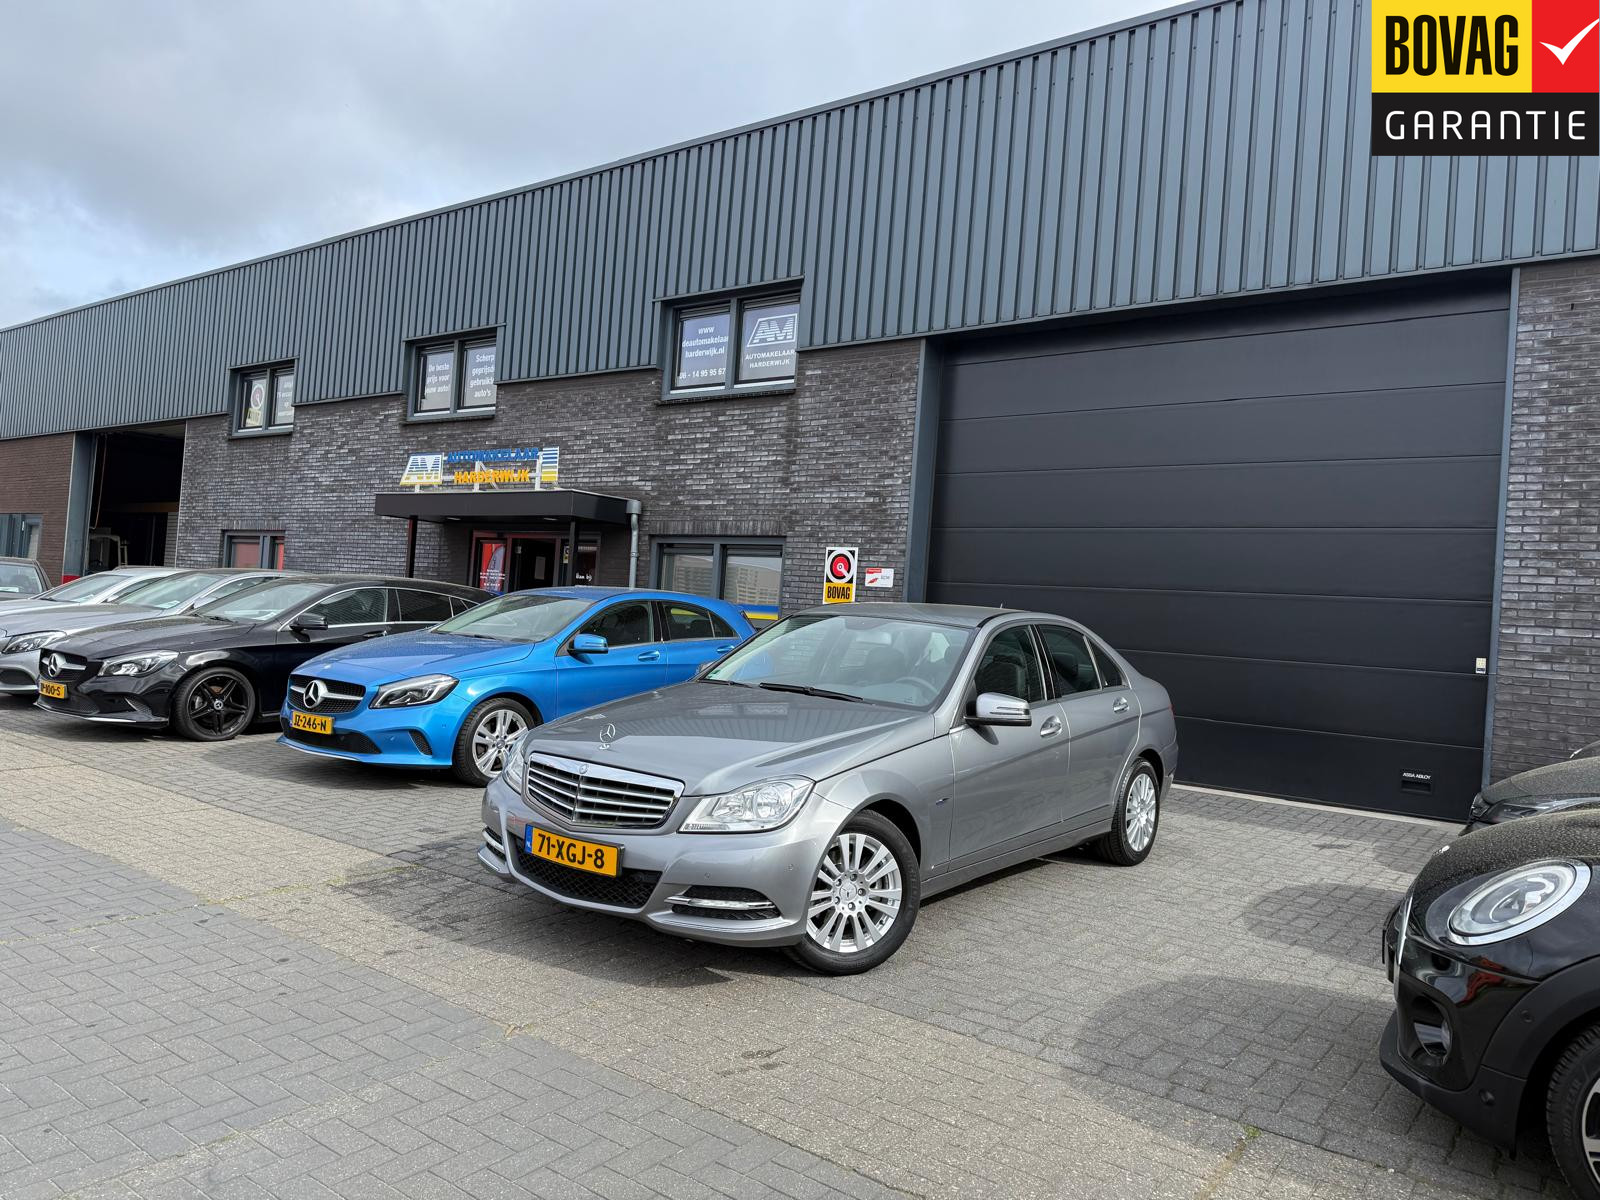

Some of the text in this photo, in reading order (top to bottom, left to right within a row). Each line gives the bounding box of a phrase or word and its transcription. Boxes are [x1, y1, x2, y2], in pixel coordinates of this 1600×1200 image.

[698, 326, 715, 335] www
[684, 346, 725, 359] harderwijk.nl
[745, 349, 796, 361] AUTOMAKELAAR
[436, 362, 450, 371] beste
[749, 358, 791, 369] HARDERWIJK
[471, 364, 496, 377] geprijsd
[438, 374, 450, 382] voor
[469, 376, 495, 389] gebruikt
[447, 447, 540, 464] AUTOMAKELAAR
[453, 468, 530, 484] HARDERWIJK
[826, 585, 851, 600] BOVAG
[293, 714, 327, 732] JZ-246-N
[537, 832, 605, 870] 71-XGJ-8
